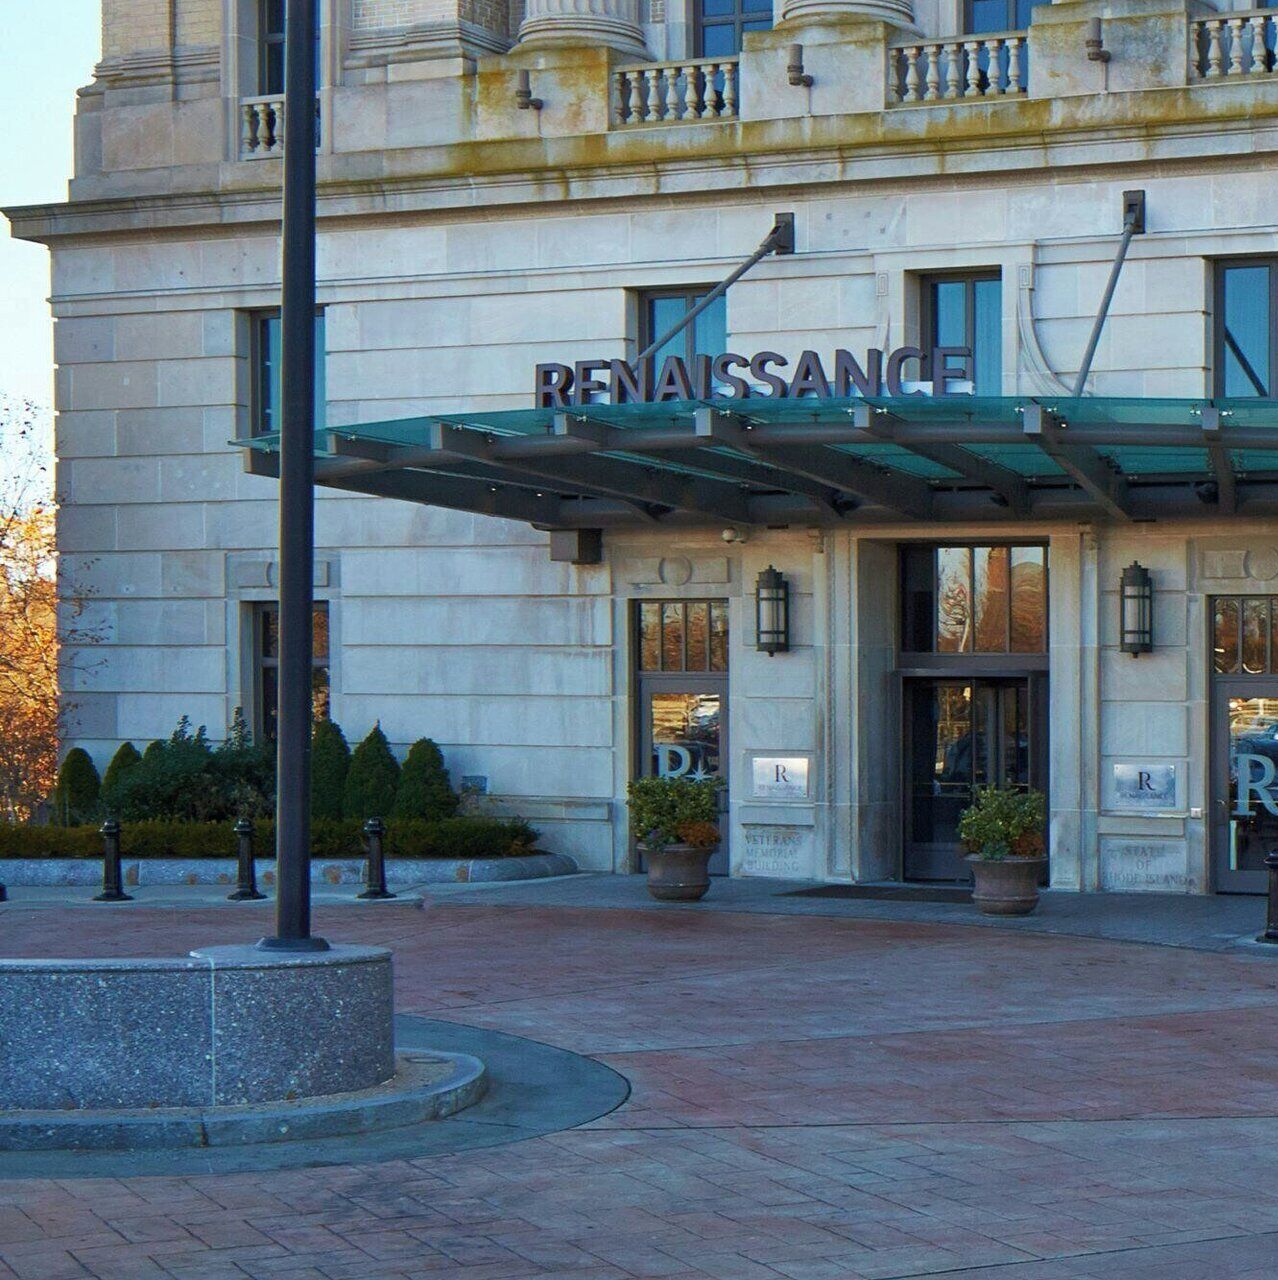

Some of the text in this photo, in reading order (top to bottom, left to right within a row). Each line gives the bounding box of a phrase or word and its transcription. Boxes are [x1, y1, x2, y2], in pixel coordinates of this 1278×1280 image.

[535, 346, 975, 409] RENAISSANCE
[775, 764, 789, 783] R
[1138, 771, 1155, 791] R
